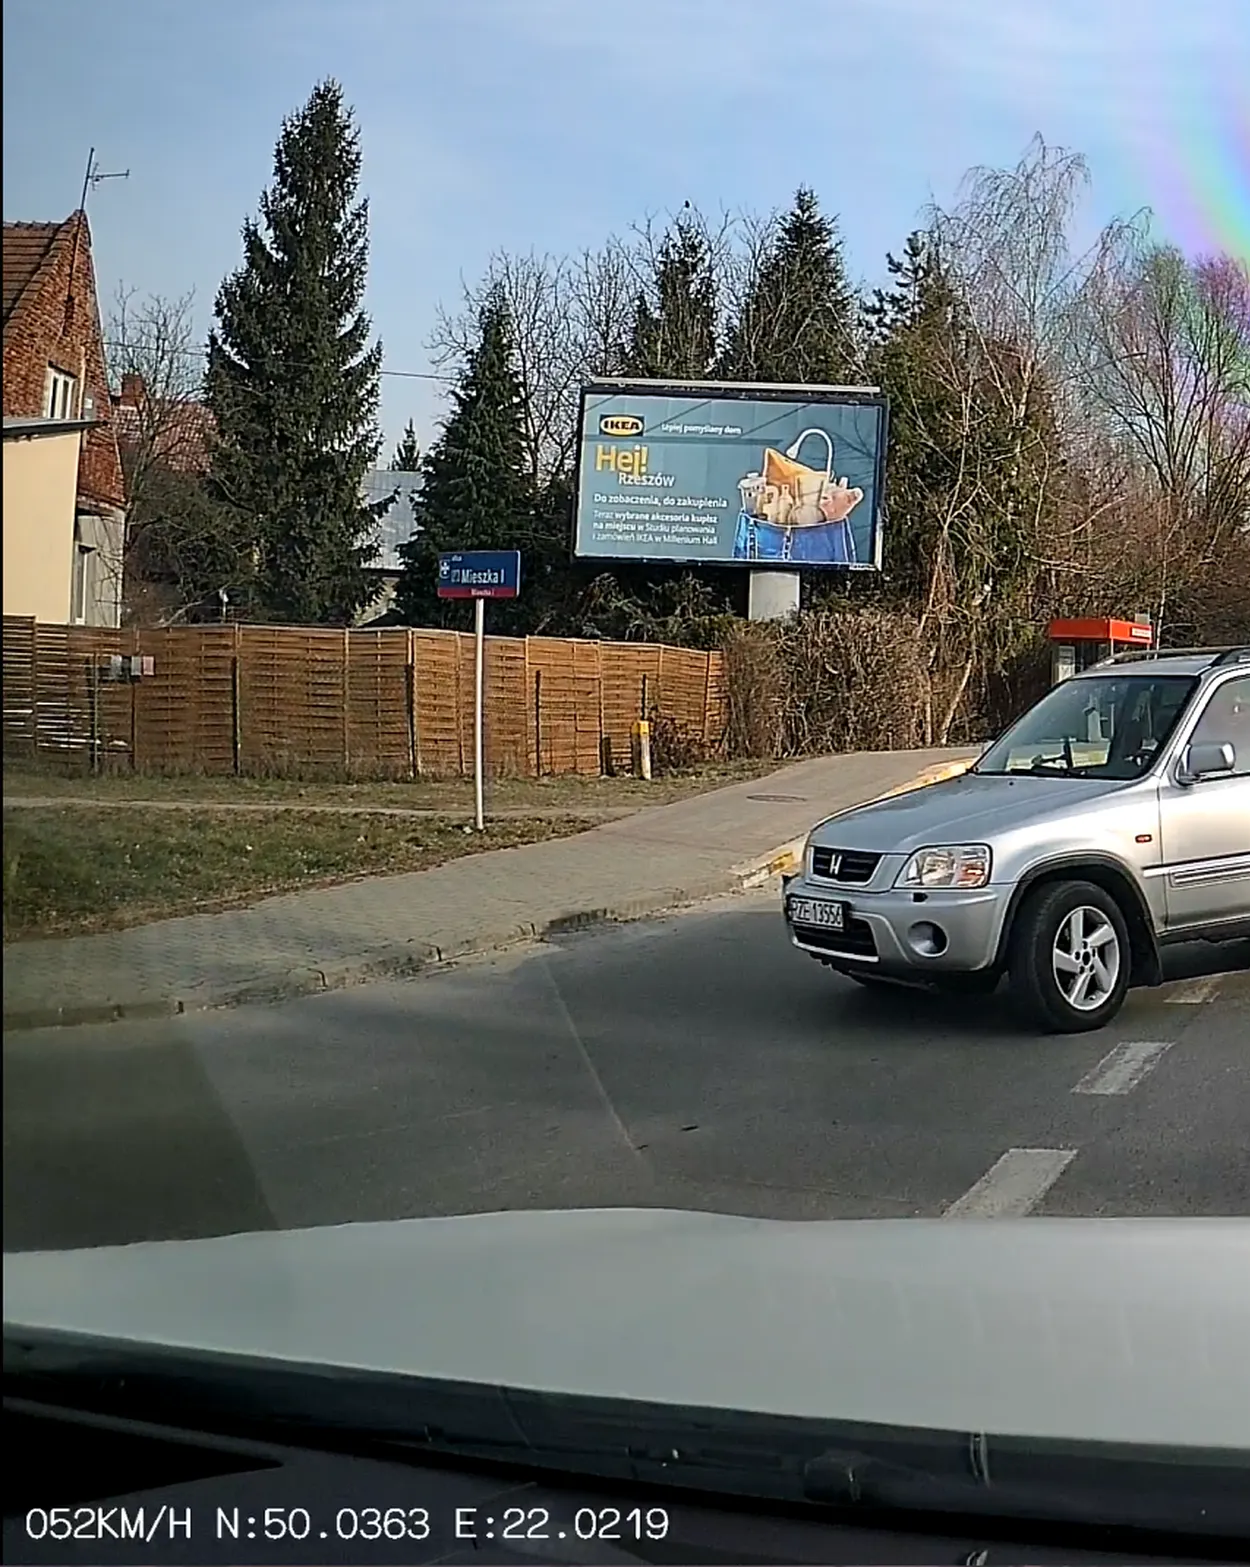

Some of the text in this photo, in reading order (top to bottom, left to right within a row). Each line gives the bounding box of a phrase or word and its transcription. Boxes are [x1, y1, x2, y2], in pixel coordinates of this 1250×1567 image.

[604, 419, 640, 431] IKEA
[595, 444, 648, 474] Hej!
[618, 472, 675, 487] Rzeszów
[594, 493, 728, 509] Do zobaczenia, do zakupienia
[461, 568, 499, 584] Mieszka
